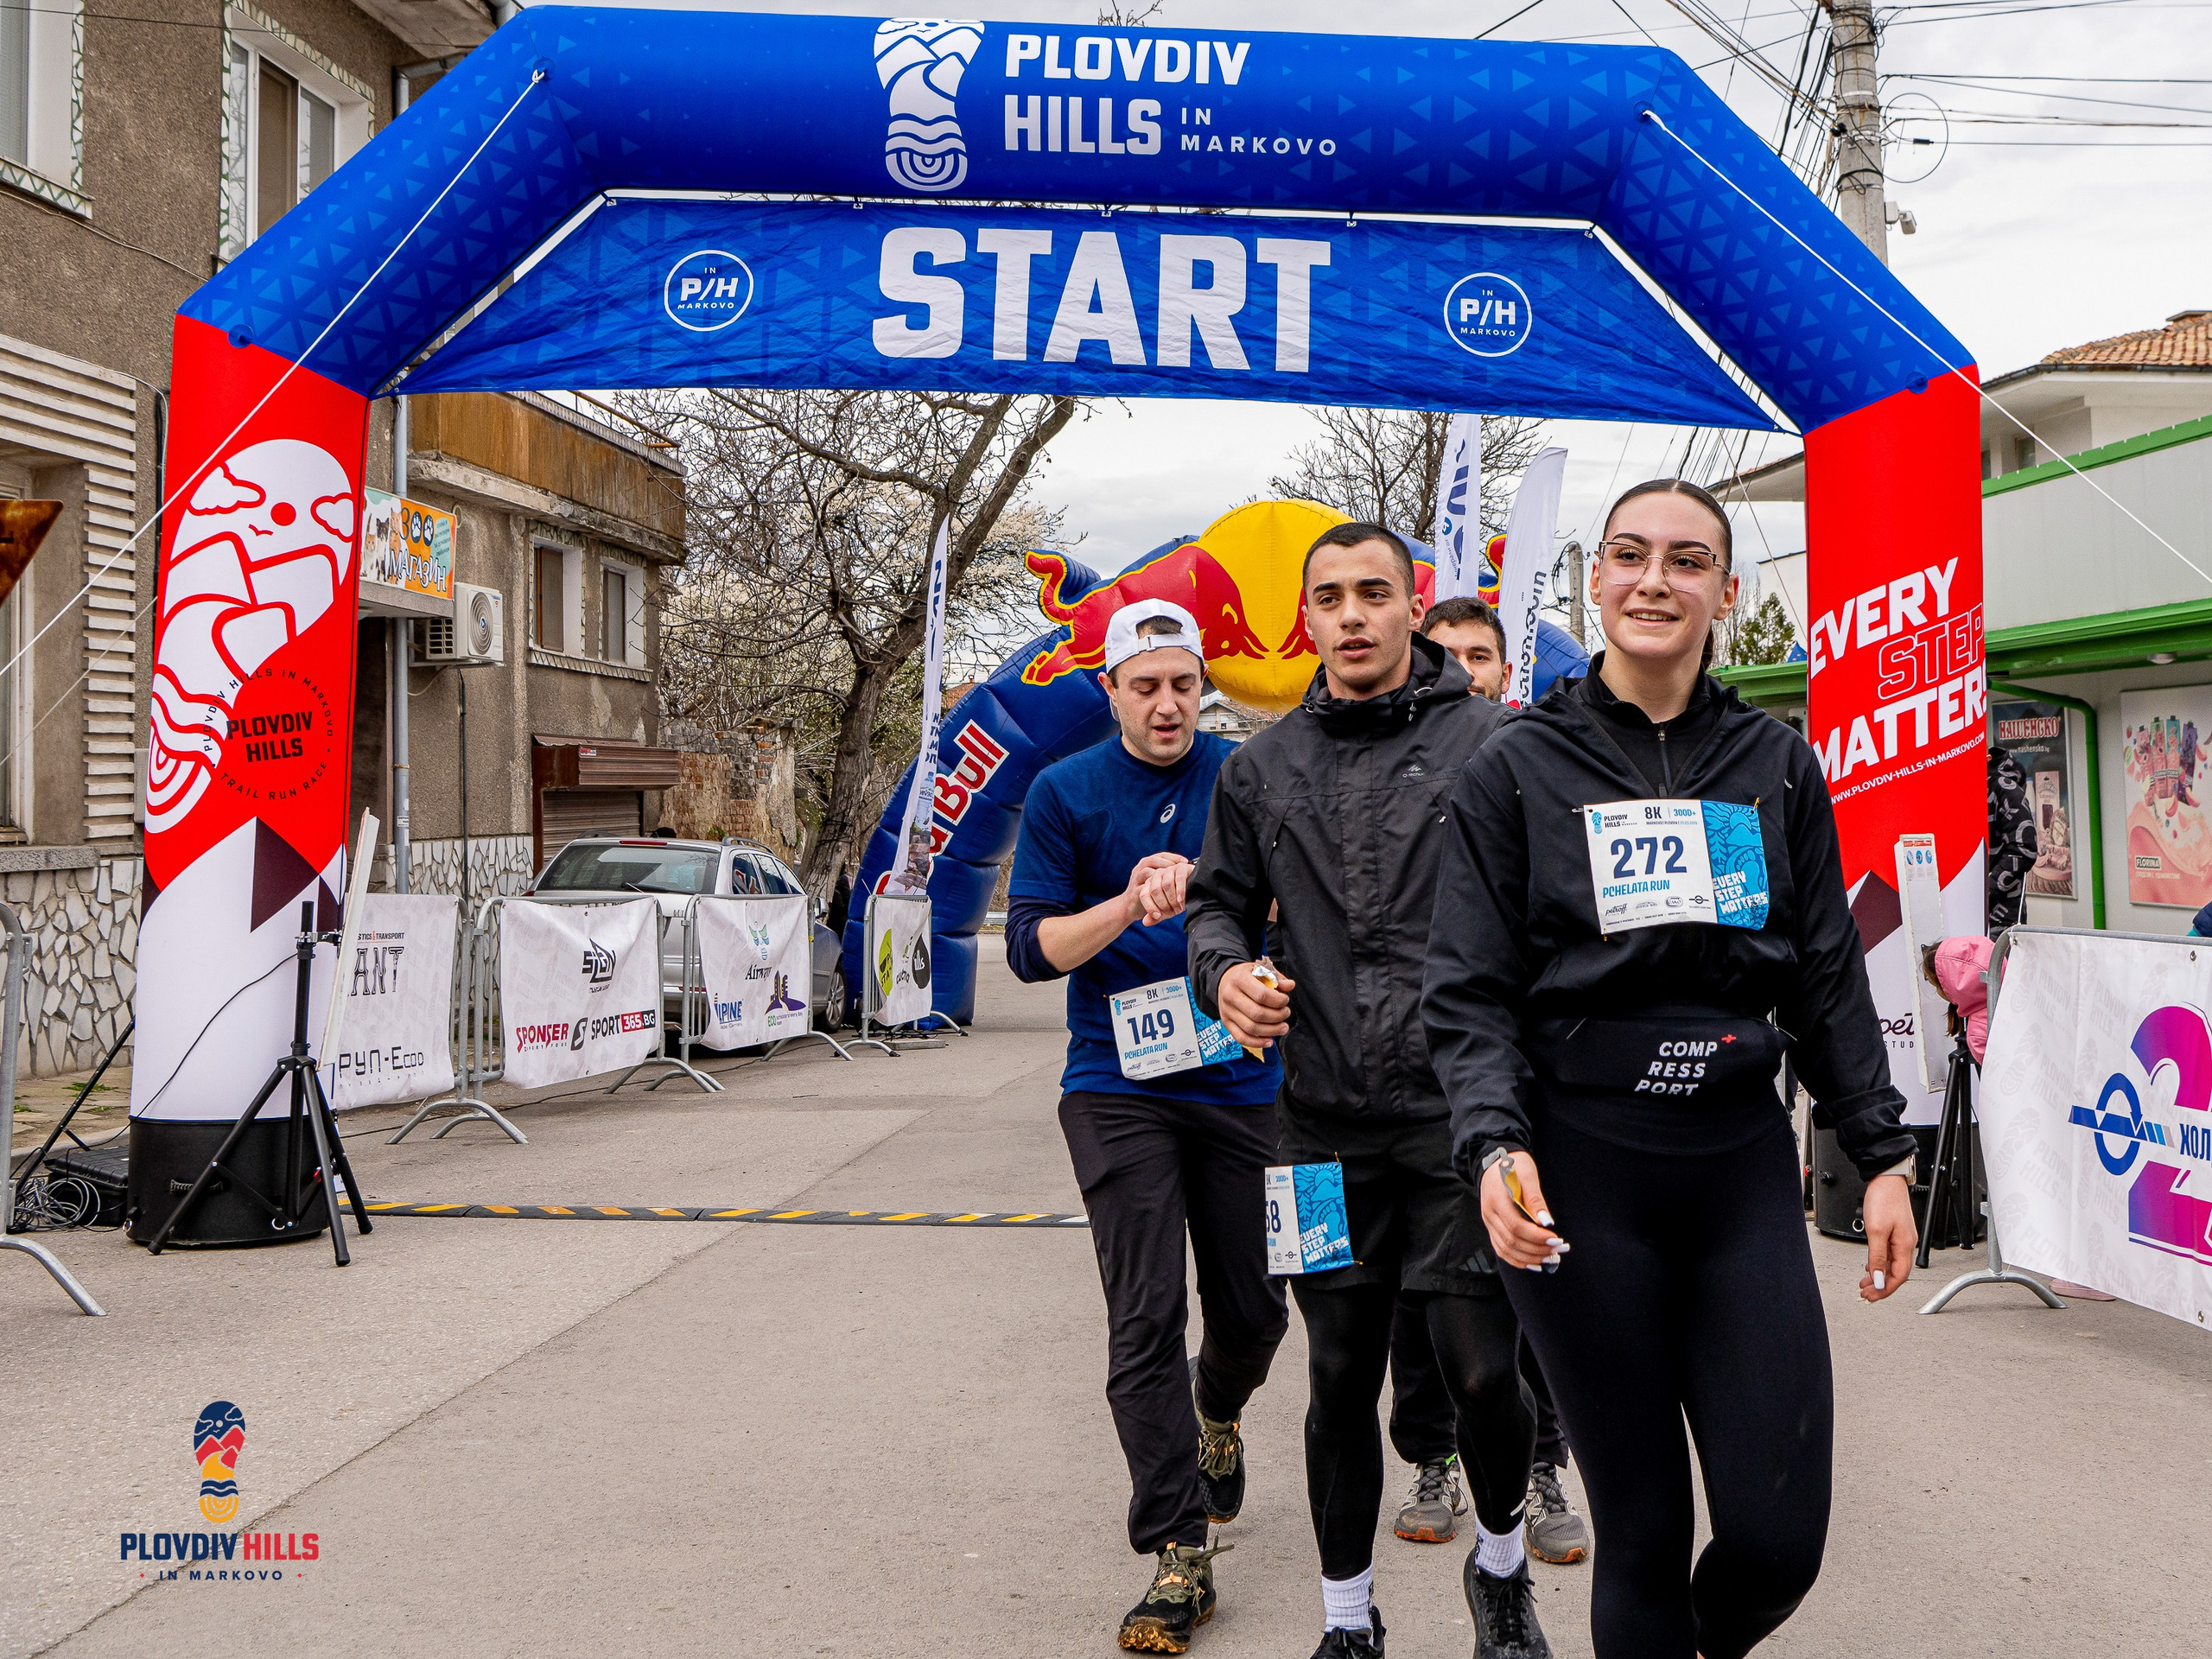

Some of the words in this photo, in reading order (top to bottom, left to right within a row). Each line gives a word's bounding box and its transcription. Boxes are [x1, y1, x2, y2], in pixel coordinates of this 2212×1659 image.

[1005, 34, 1251, 86] PLOVDIV
[1004, 94, 1161, 156] HILLS
[1181, 107, 1211, 125] IN
[1180, 134, 1337, 156] MARKOVO
[680, 277, 739, 302] P/H
[872, 226, 1332, 372] START
[1460, 298, 1516, 326] P/H
[1460, 327, 1516, 337] MARKOVO
[389, 549, 446, 592] МАГАЗИН
[1810, 556, 1958, 679] EVERY
[1878, 602, 1985, 700] STEP
[203, 690, 226, 752] PLOVDIV
[229, 669, 272, 690] HILLS
[283, 669, 296, 679] IN
[302, 677, 334, 736] MARKOVO
[226, 711, 313, 740] PLOVDIV
[1999, 716, 2059, 740] НАШЕНСКО
[246, 738, 303, 762] HILLS
[220, 772, 258, 798] TRAIL
[269, 788, 296, 800] RUN
[302, 761, 327, 791] RACE
[932, 722, 1007, 823] Bull
[1644, 806, 1662, 819] 8K
[1611, 836, 1687, 880] 272
[2136, 857, 2160, 868] FLORINA
[1603, 881, 1649, 899] PCHELATA
[1650, 880, 1670, 891] RUN
[1713, 871, 1746, 891] EVERY
[1714, 885, 1745, 901] STEP
[1719, 893, 1768, 914] MATTERS
[1147, 988, 1159, 1000] 8K
[516, 1023, 569, 1053] SPONSER
[591, 1014, 620, 1040] SPORT
[1127, 1008, 1175, 1045] 149
[1197, 1020, 1222, 1042] EVERY
[1124, 1045, 1154, 1060] PCHELATA
[1154, 1042, 1168, 1053] RUN
[1198, 1033, 1219, 1050] STEP
[1203, 1033, 1236, 1058] MATTER
[1659, 1041, 1718, 1057] COMP
[1648, 1061, 1706, 1077] RESS
[1634, 1079, 1699, 1096] PORT
[2179, 1123, 2211, 1161] ХОЛ
[1300, 1223, 1328, 1244] EVERY
[1301, 1236, 1325, 1254] STEP
[1305, 1236, 1350, 1264] MATTERS
